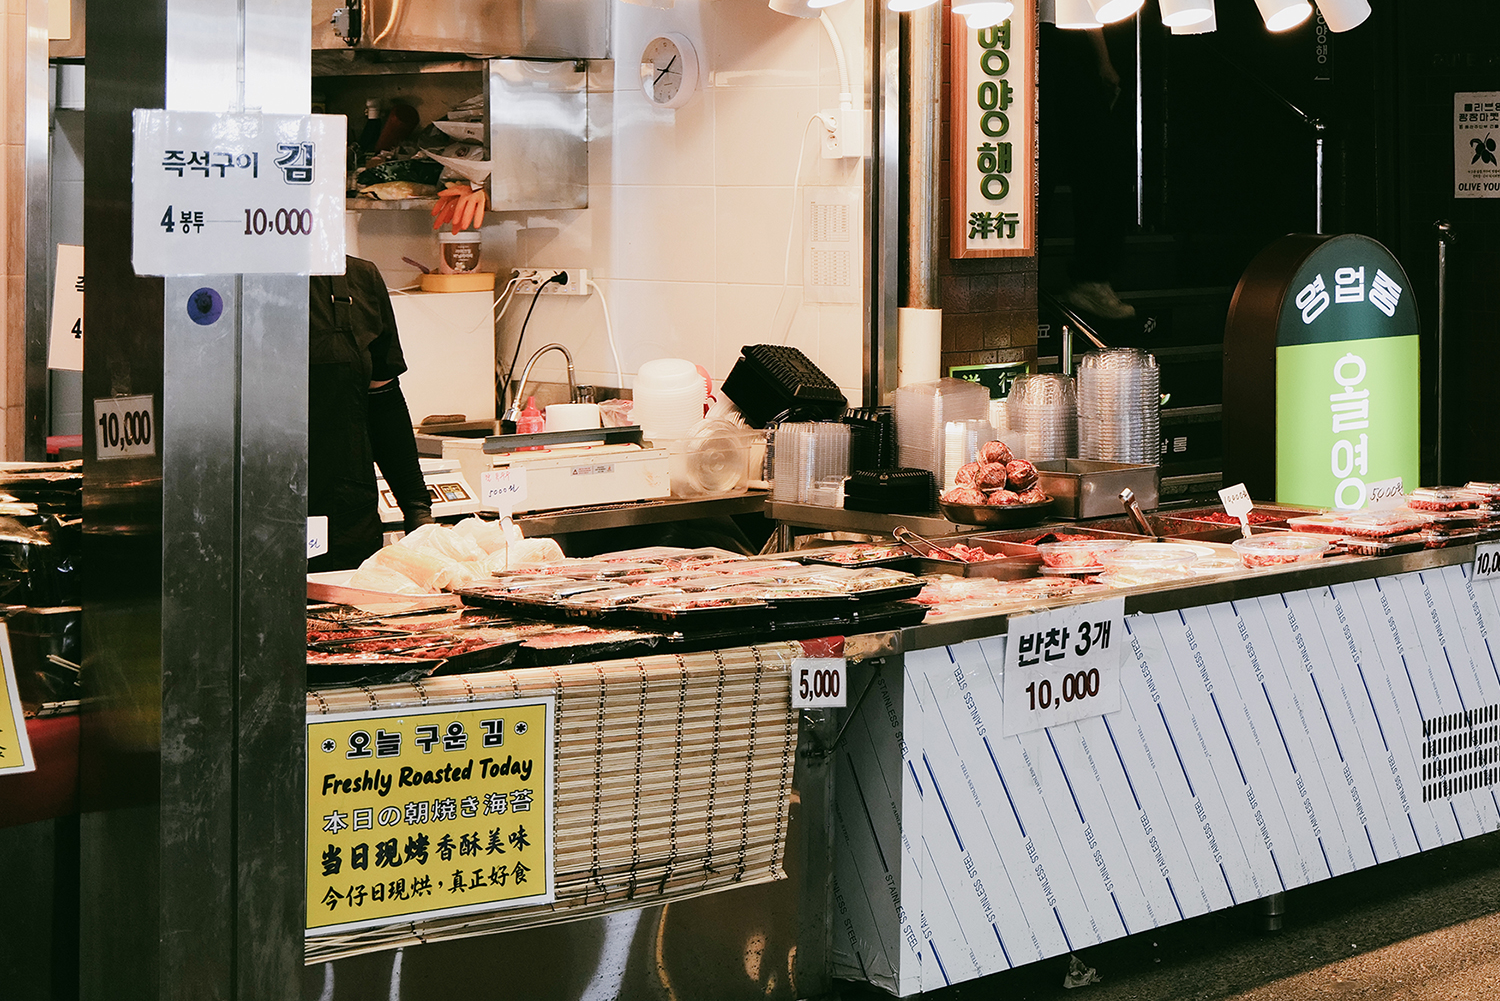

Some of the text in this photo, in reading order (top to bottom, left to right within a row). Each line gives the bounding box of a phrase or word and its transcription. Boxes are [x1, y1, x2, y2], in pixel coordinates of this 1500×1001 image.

[976, 19, 1014, 202] 영양행
[161, 141, 316, 185] 즉석구이 김
[1458, 183, 1481, 192] OLIVE
[161, 204, 314, 237] 4 봉투 10,000
[968, 212, 1020, 240] 洋行
[1295, 266, 1403, 325] 영업중
[71, 318, 82, 338] 4
[99, 410, 151, 451] 10,000
[1335, 601, 1359, 664] STAINLESS STEEL
[1381, 594, 1404, 655] STAINLESS STEEL
[1423, 586, 1446, 646] STAINLESS STEEL
[1465, 578, 1487, 638] STAINLESS STEEL
[1018, 620, 1111, 667] 반찬 3개
[1130, 635, 1160, 703] STAINLESS STEEL
[1185, 627, 1213, 693] STAINLESS STEEL
[1237, 617, 1264, 683] STAINLESS STEEL
[1286, 609, 1313, 674] STAINLESS STEEL
[798, 667, 840, 702] 5,000
[954, 664, 986, 737] STAINLESS STEEL
[1026, 668, 1100, 711] 10,000
[346, 718, 504, 759] 오늘 구운 김
[877, 677, 910, 760] STAINLESS STEEL
[322, 755, 533, 796] Freshly Roasted Today
[1295, 773, 1321, 837] STAINLESS STEEL
[1342, 762, 1367, 825] STAINLESS STEEL
[1387, 752, 1410, 814] STAINLESS STEEL
[323, 789, 533, 834] 本日の朝焼き海苔
[1194, 797, 1223, 865] STAINLESS STEEL
[1246, 786, 1272, 852] STAINLESS STEEL
[1025, 838, 1056, 908] STAINLESS STEEL
[1084, 824, 1115, 893] STAINLESS STEEL
[1140, 810, 1170, 878] STAINLESS STEEL
[885, 873, 919, 953] STAINLESS STEEL
[962, 852, 996, 923] STAINLESS STEEL
[844, 918, 859, 946] STEEL
